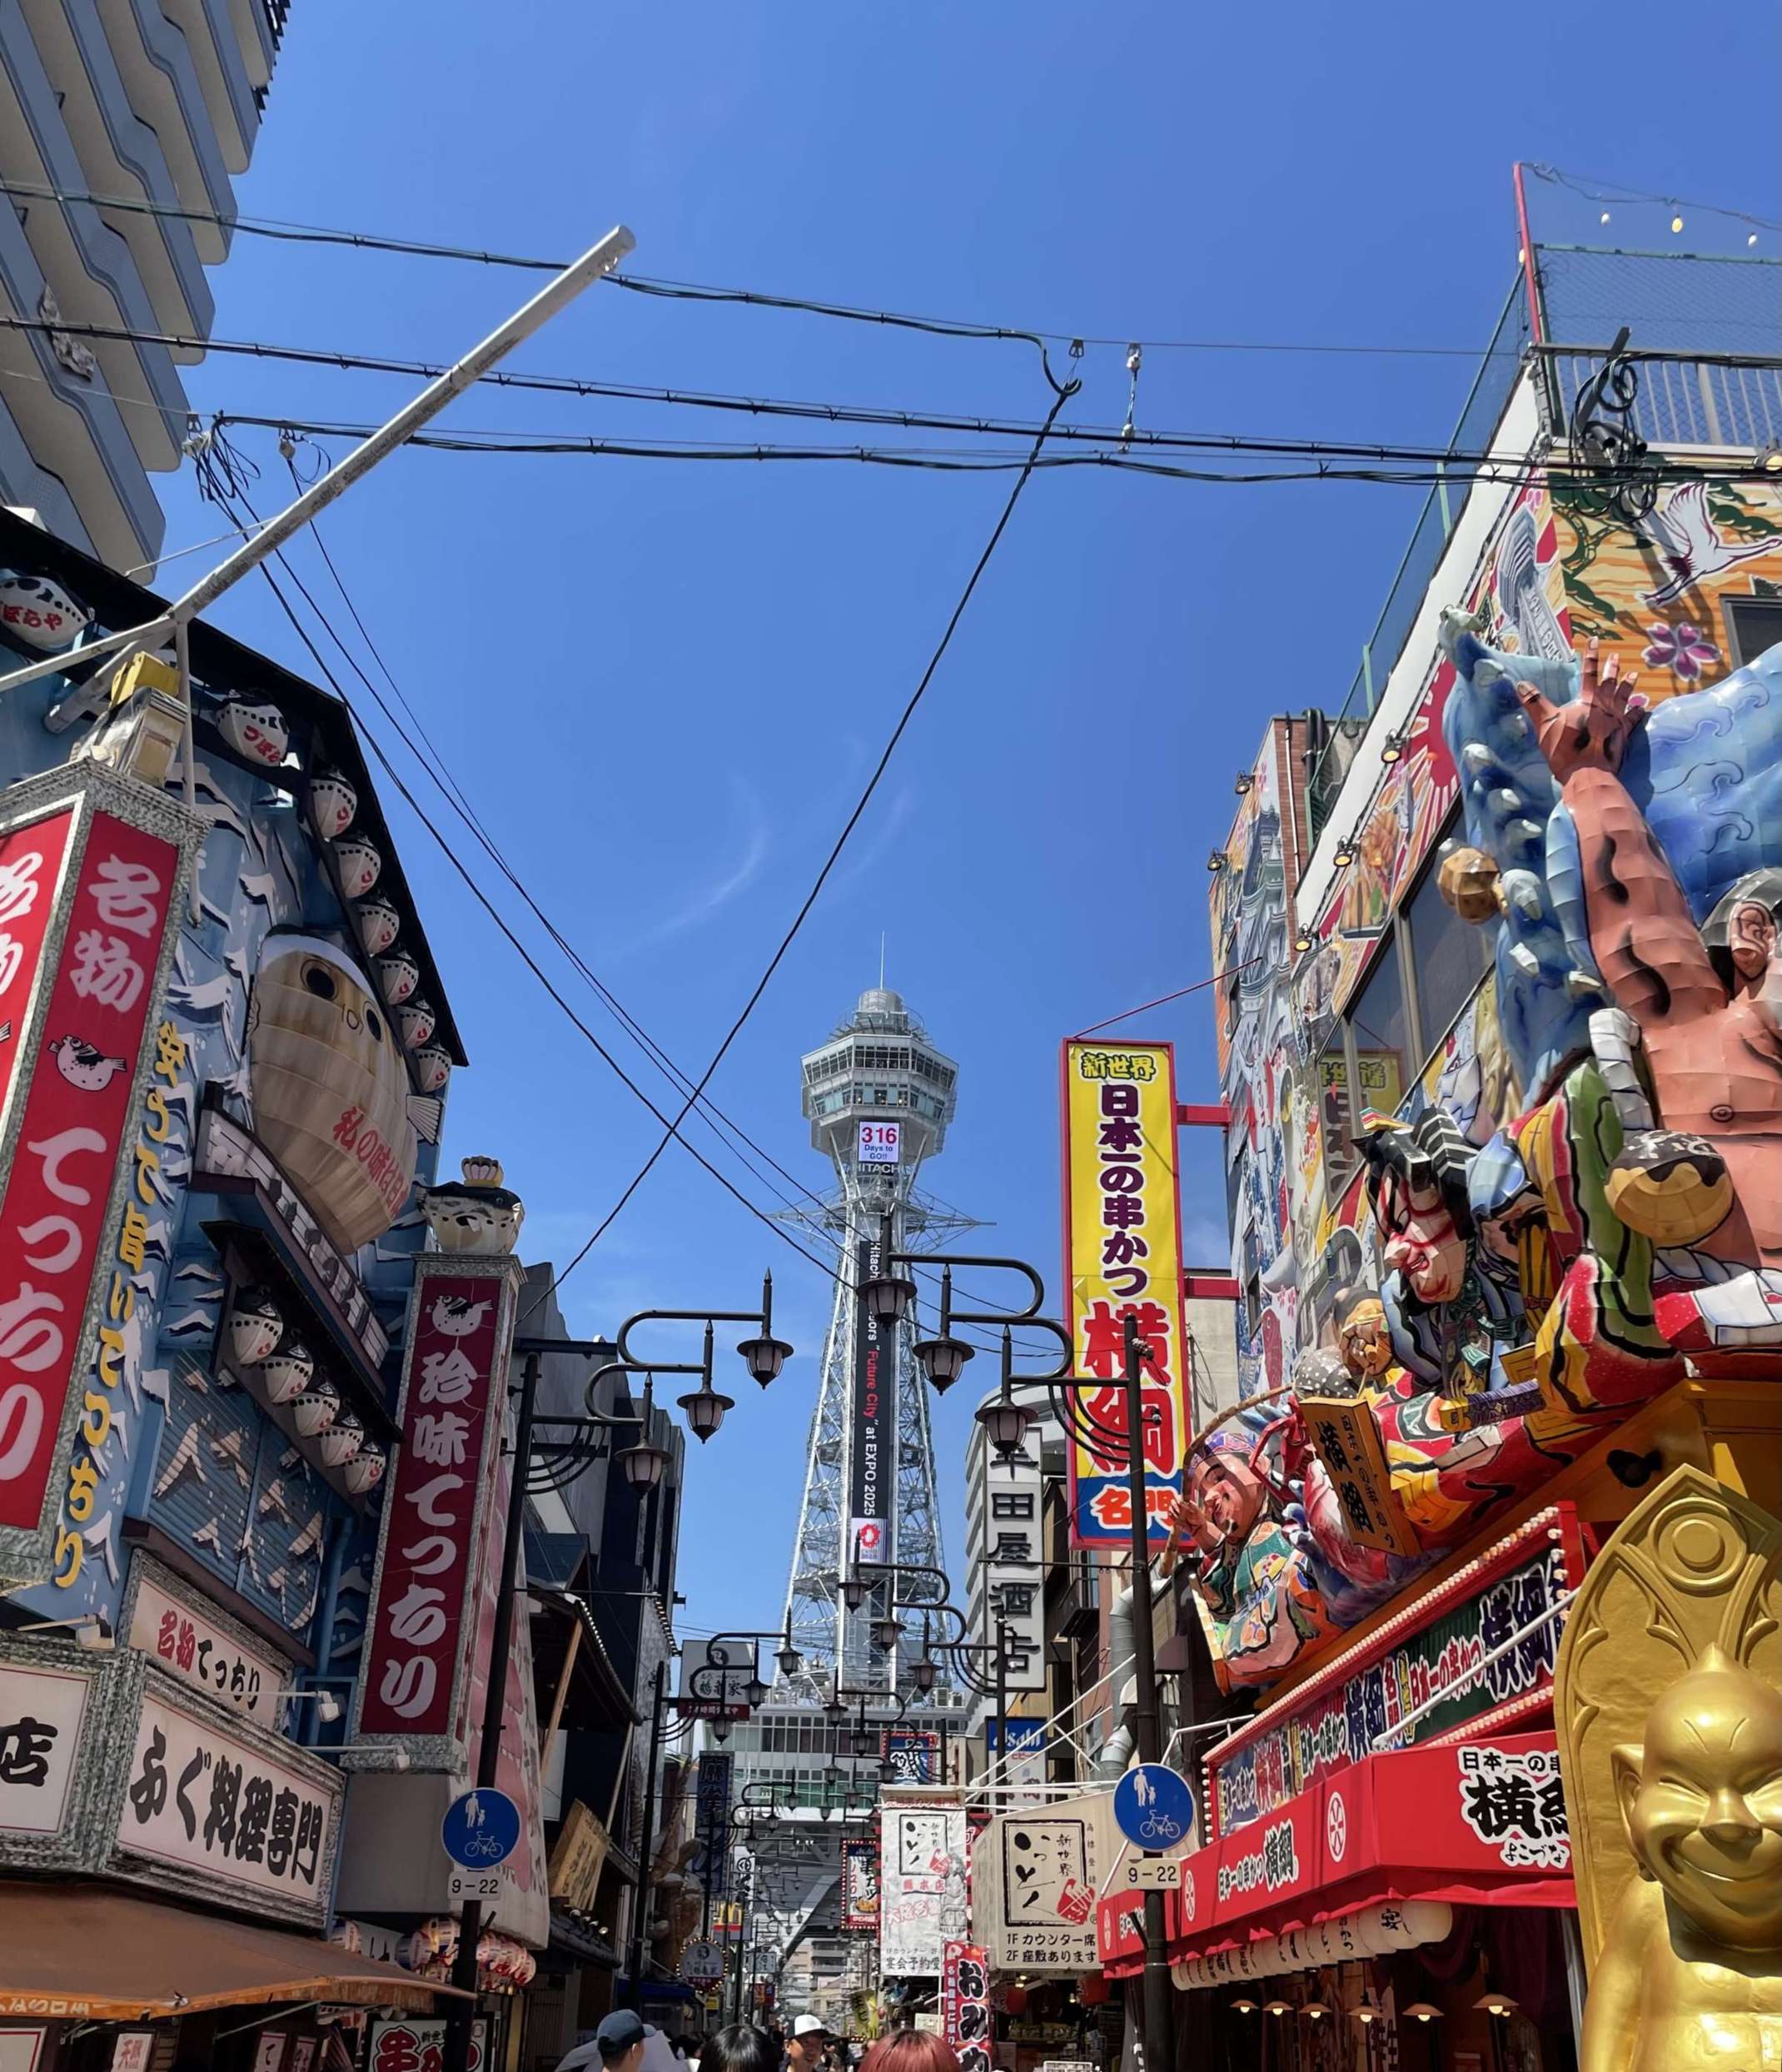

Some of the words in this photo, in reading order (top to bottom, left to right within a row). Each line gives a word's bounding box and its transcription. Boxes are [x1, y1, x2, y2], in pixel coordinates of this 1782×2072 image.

[1082, 1052, 1156, 1081] 新世界
[862, 1127, 897, 1143] 316
[1098, 1084, 1148, 1297] 日本一の串かつ
[1083, 1301, 1174, 1476] 横綱
[866, 1427, 876, 1440] at
[865, 1443, 877, 1481] EXPO
[864, 1485, 876, 1517] 2025
[380, 1348, 479, 1718] 珍味てっちり
[157, 1609, 261, 1711] 名物てっちり
[130, 1724, 324, 1886] ふぐ料理専門
[1506, 1843, 1566, 1864] よこづな
[451, 1879, 499, 1894] 9-22
[1128, 1865, 1177, 1882] 9-22
[1007, 1934, 1018, 1945] 1F
[1006, 1950, 1018, 1961] 2F
